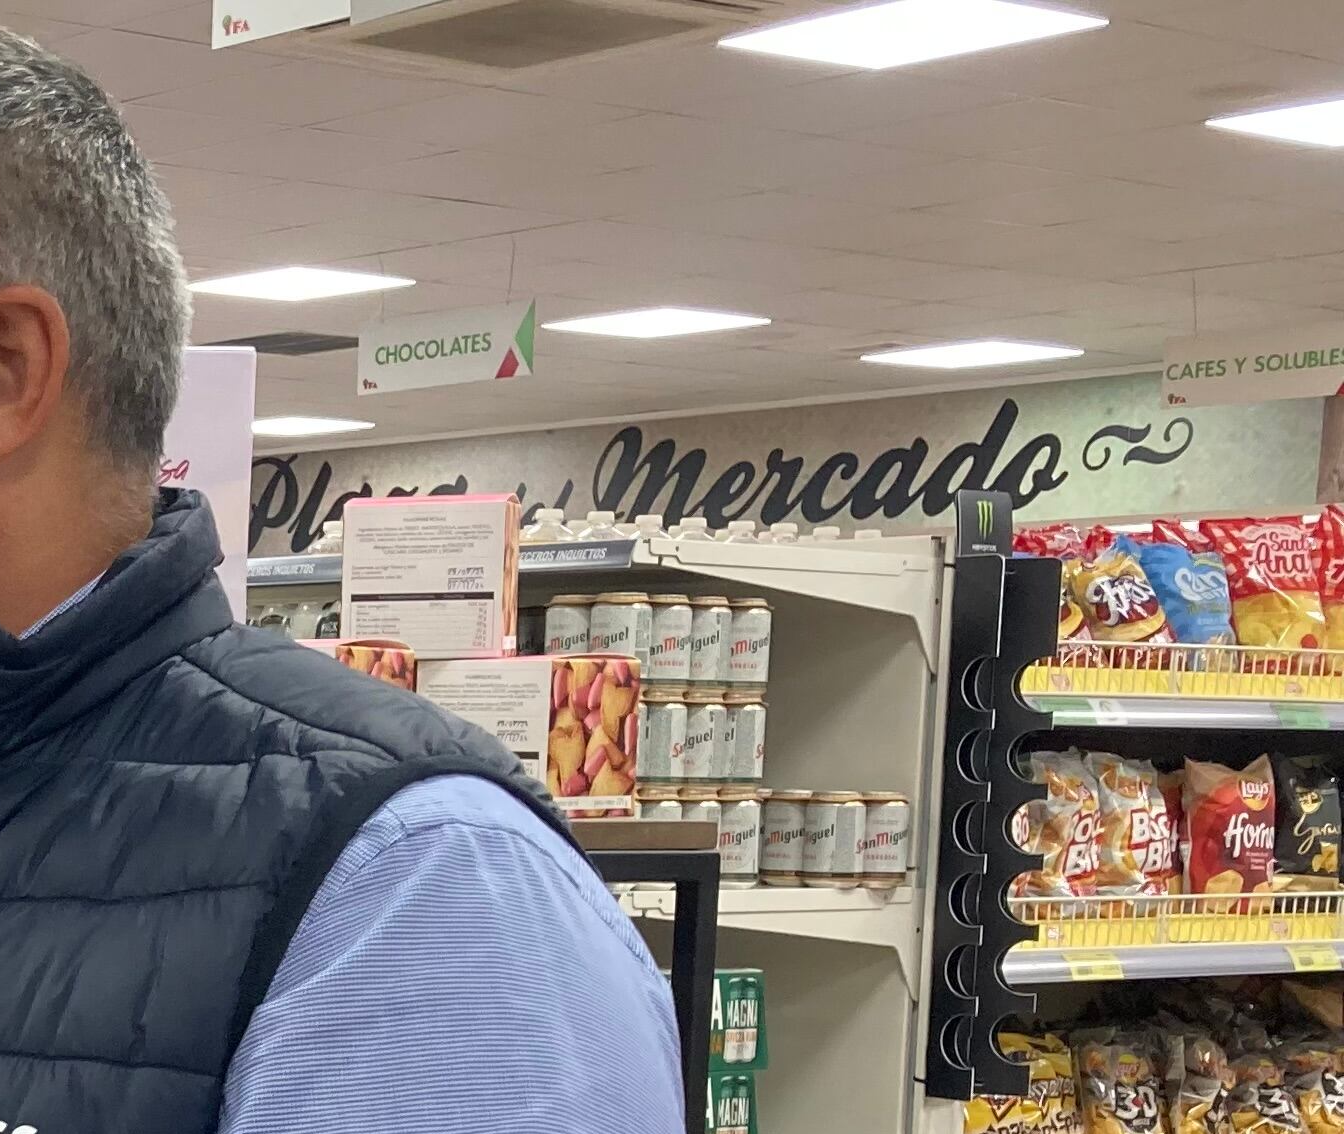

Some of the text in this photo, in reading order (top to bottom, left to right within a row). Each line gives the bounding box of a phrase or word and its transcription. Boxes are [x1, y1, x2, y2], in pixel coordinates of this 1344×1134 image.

[374, 331, 493, 367] CHOCOLATES
[1166, 359, 1227, 381] CAFES
[1235, 356, 1247, 375] Y
[593, 398, 1070, 530] Mercado
[557, 546, 607, 562] INQUIETOS
[1253, 542, 1310, 576] Ana
[273, 563, 315, 576] INQUIETOS
